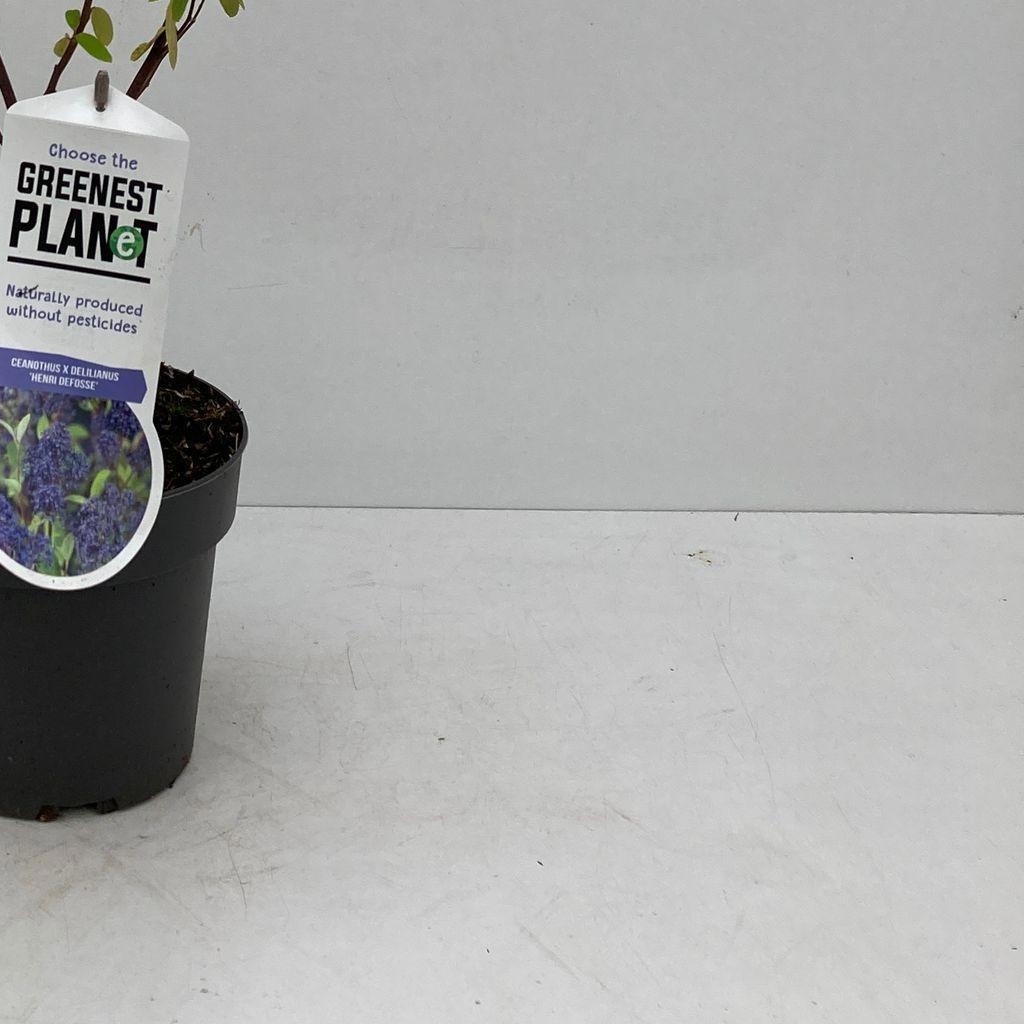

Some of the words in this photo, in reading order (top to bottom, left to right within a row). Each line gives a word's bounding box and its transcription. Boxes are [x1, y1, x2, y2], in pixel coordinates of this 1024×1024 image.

[49, 143, 107, 165] Choose
[112, 152, 138, 170] the
[17, 161, 163, 215] GREENEST
[6, 283, 70, 307] Naturally
[76, 295, 143, 317] produced
[6, 305, 62, 323] without
[67, 313, 138, 335] pesticides
[11, 357, 61, 373] CEANOTHUS
[62, 365, 70, 374] X
[71, 366, 119, 381] DELILIANUS
